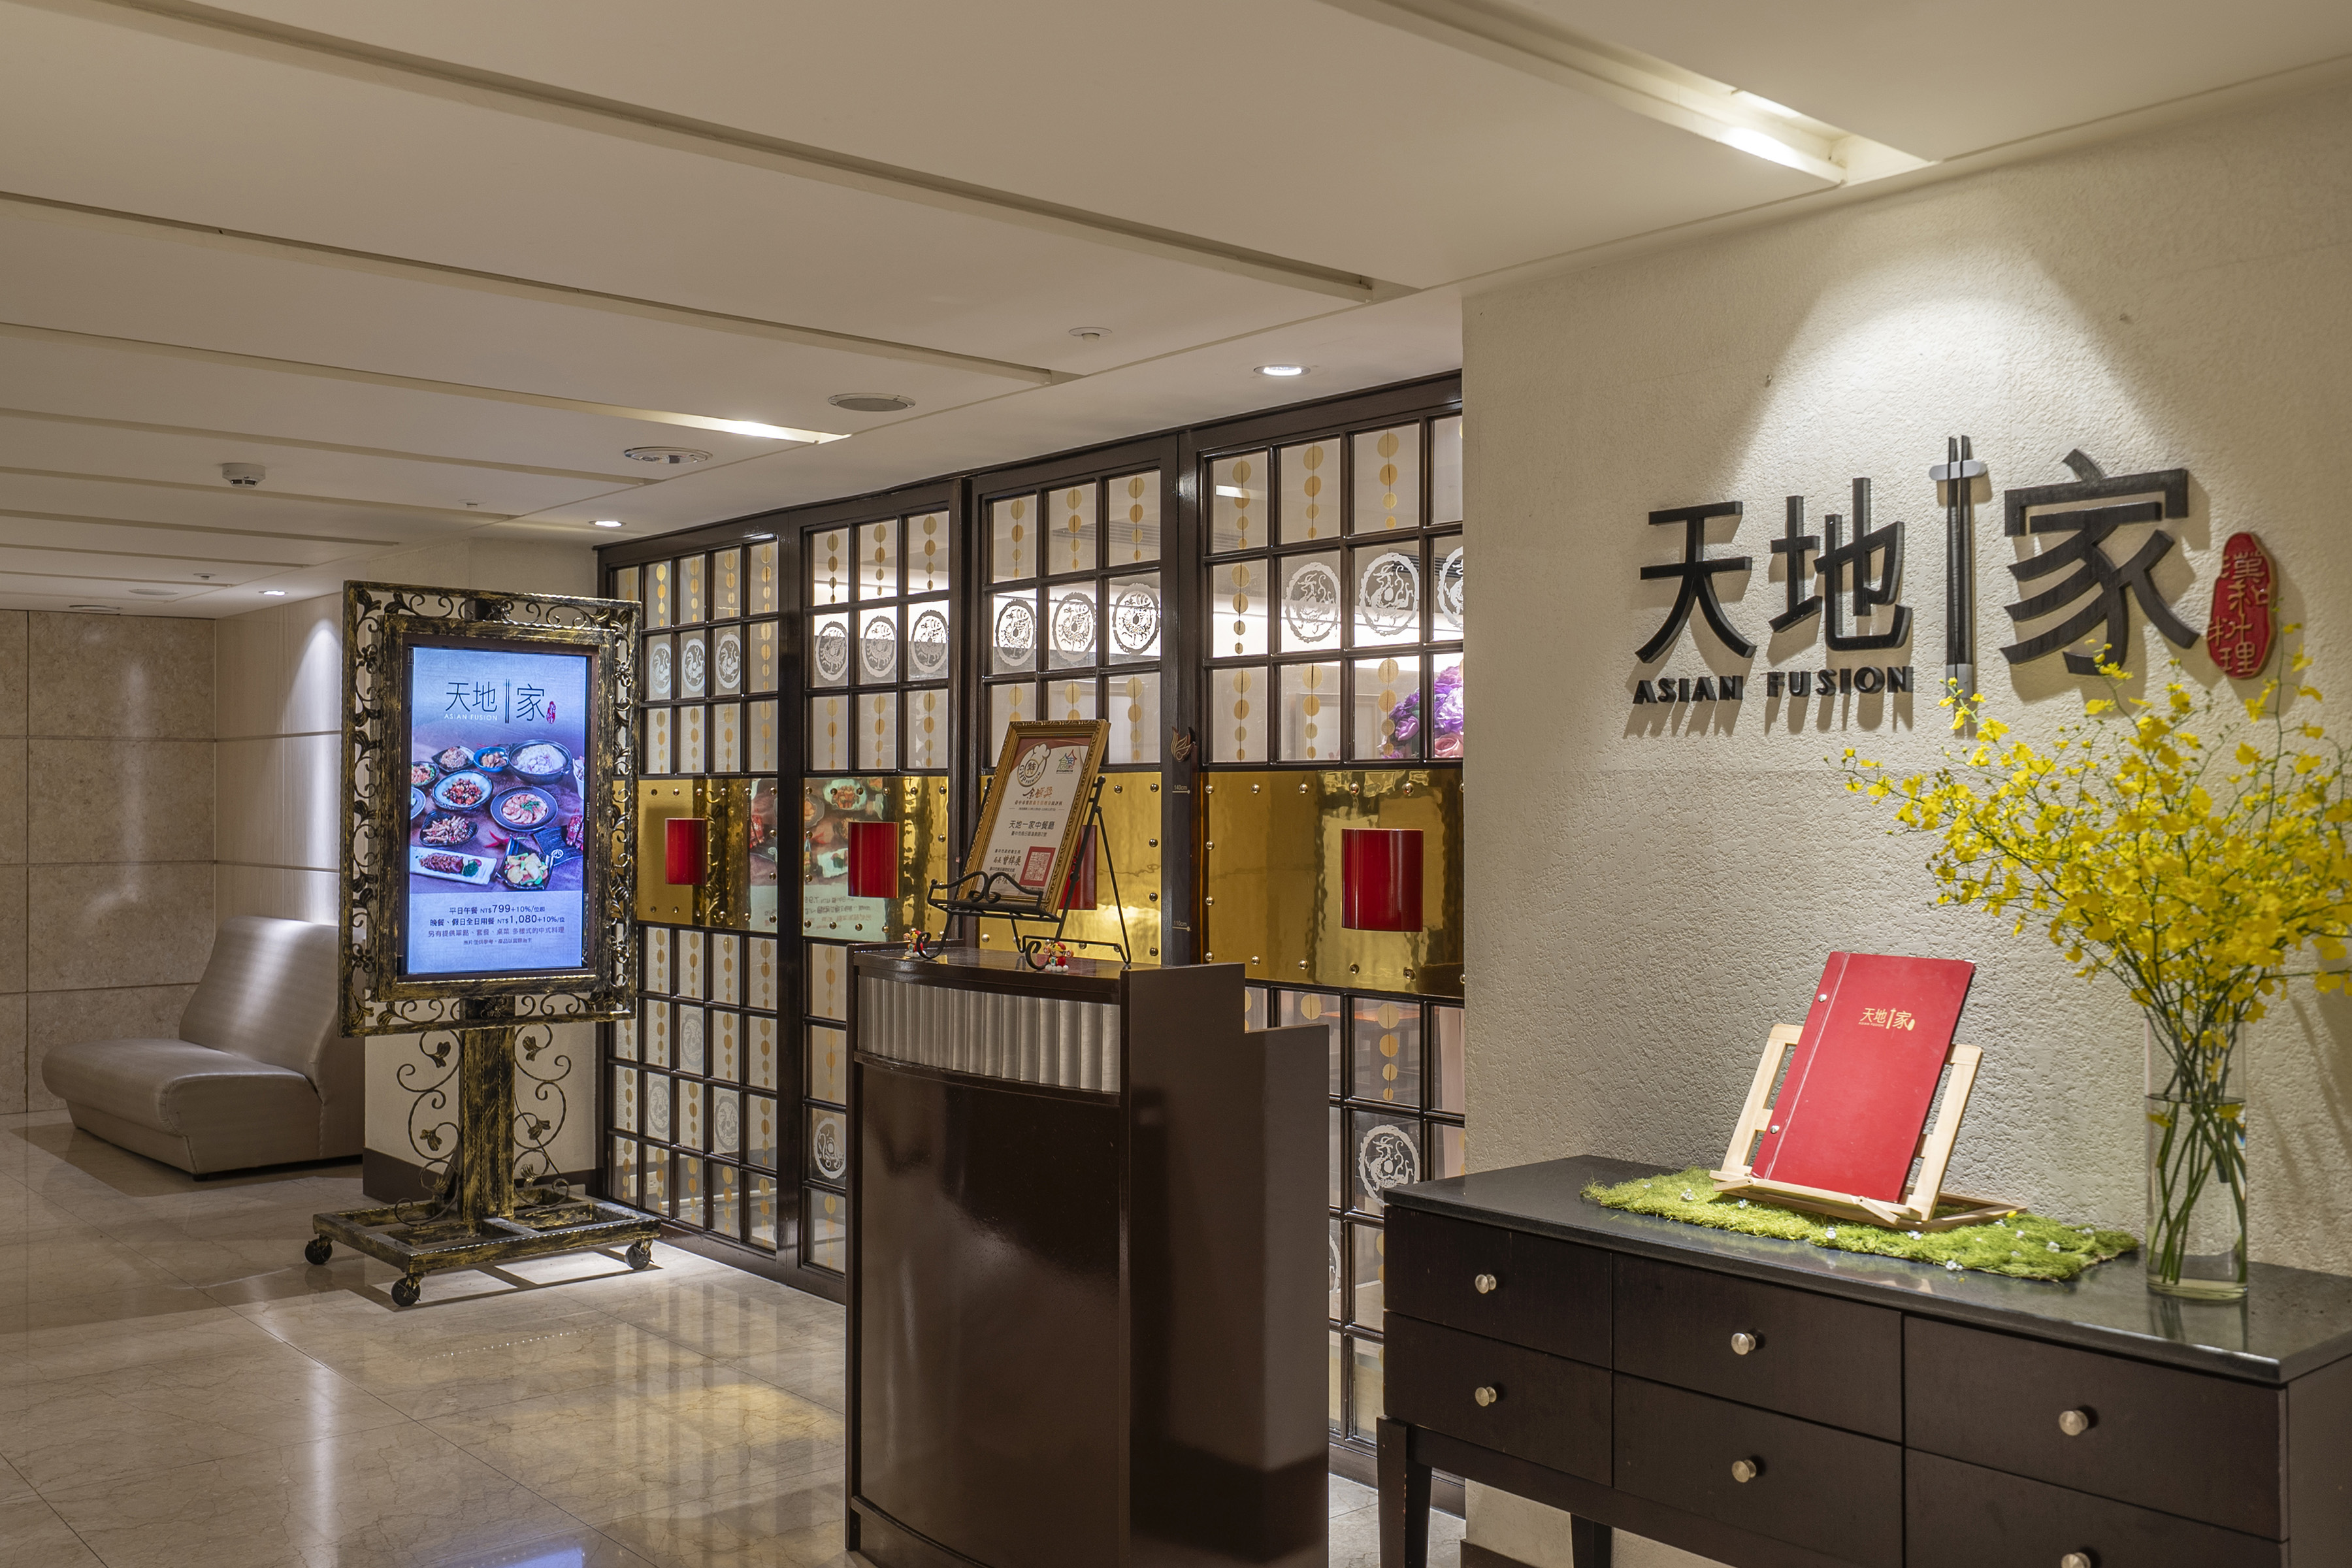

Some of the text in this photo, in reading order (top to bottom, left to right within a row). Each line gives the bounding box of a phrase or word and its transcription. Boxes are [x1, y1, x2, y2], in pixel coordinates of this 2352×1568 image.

[1633, 666, 1914, 704] ASIAN FUSION
[1008, 820, 1055, 830] 天地一家中餐廳
